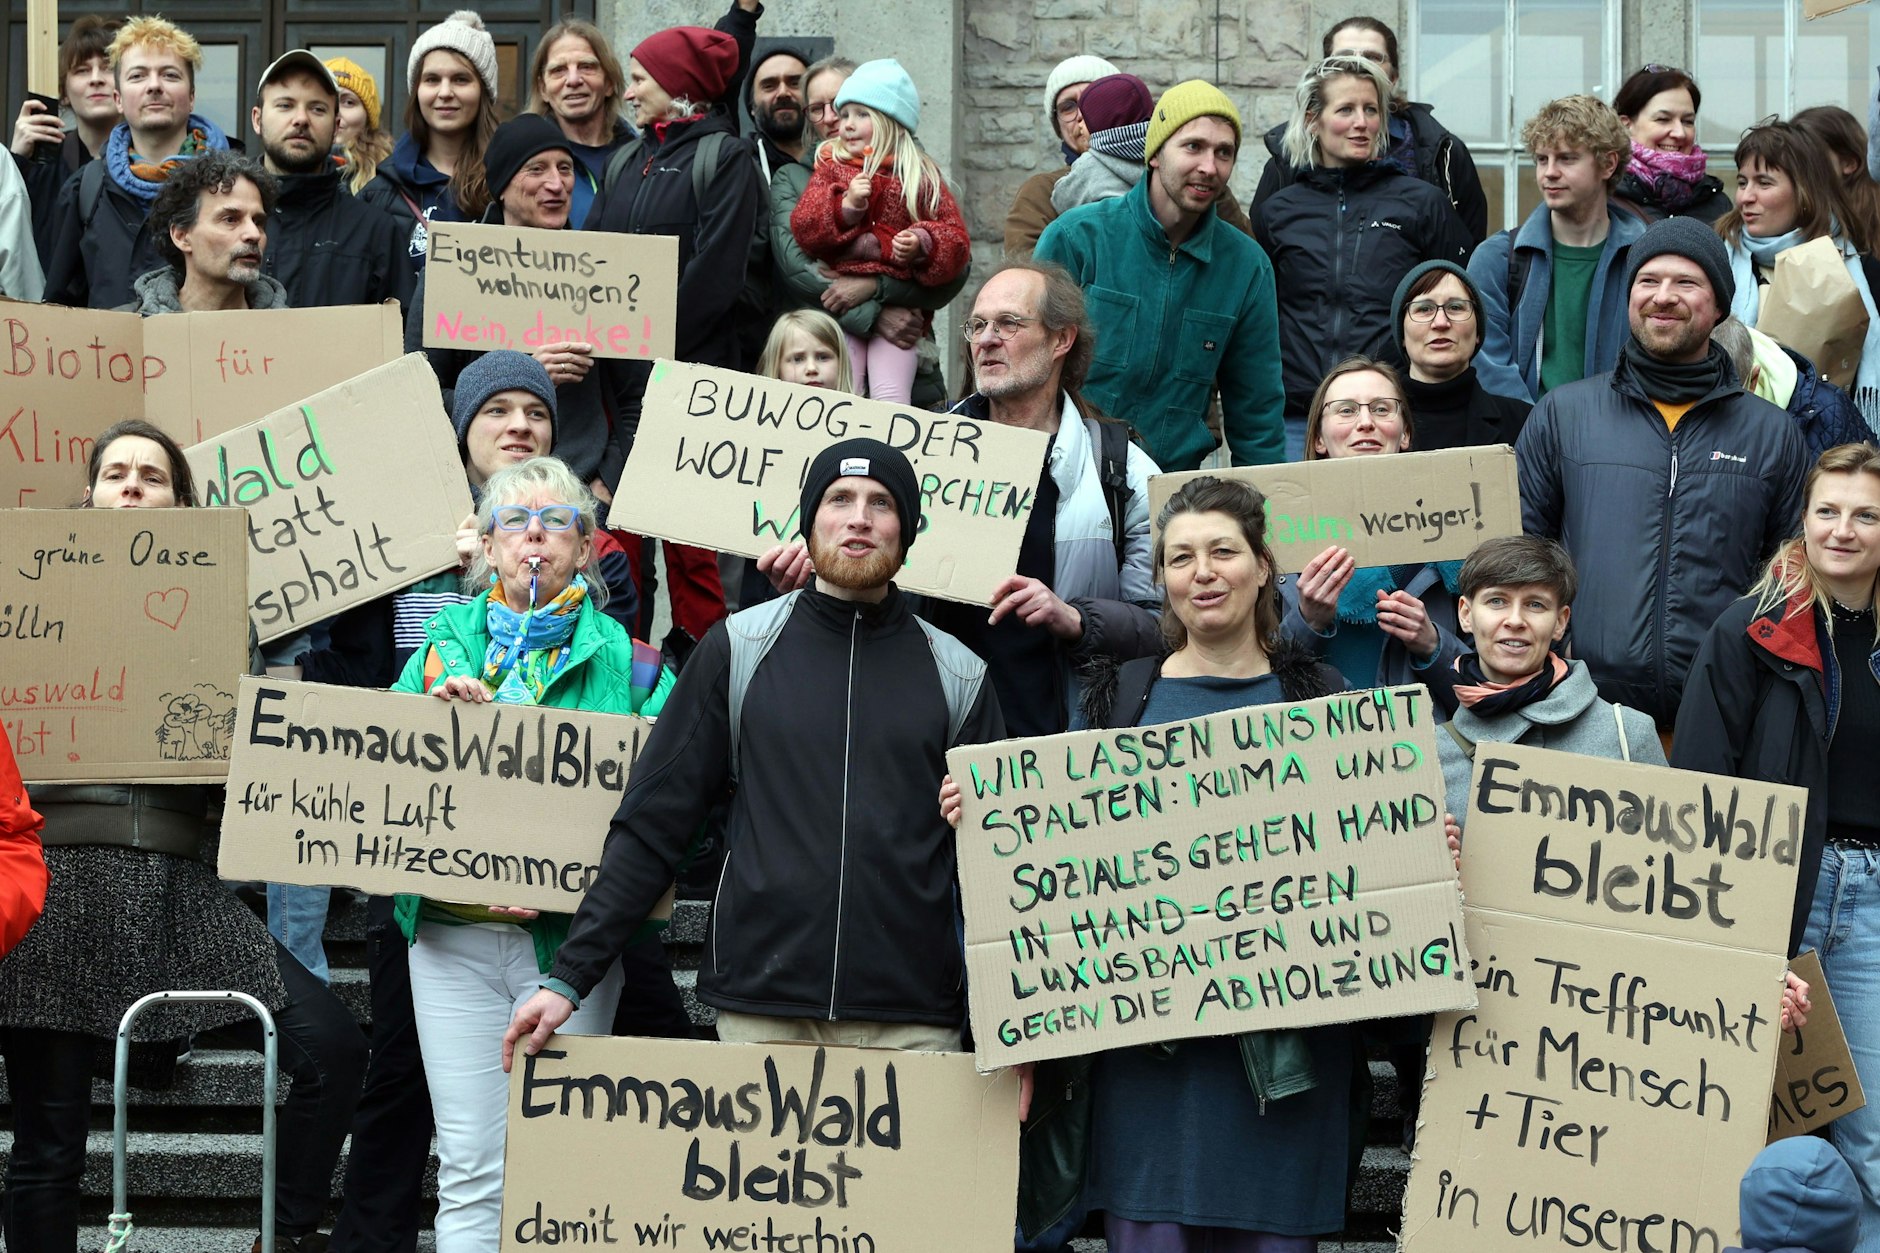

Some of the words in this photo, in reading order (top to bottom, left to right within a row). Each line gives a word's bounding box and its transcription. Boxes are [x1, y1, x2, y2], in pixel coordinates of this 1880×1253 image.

[430, 231, 607, 277] Eigentums-
[477, 272, 641, 315] wohnungen?
[3, 318, 167, 394] Biotop
[215, 340, 275, 382] für
[435, 310, 513, 349] Nein,
[522, 309, 652, 357] danke!
[675, 436, 783, 488] WOLF
[914, 458, 1033, 520] RCHEN-
[18, 533, 105, 580] grüne
[130, 530, 216, 566] Oase
[248, 486, 345, 554] tatt
[249, 522, 407, 625] sphalt
[0, 604, 64, 643] ölln
[0, 666, 126, 706] uswald
[970, 749, 1044, 800] WIR
[1065, 716, 1213, 781] LASSEN
[1232, 706, 1316, 752] UNS
[1326, 688, 1421, 740] NICHT
[1188, 752, 1311, 808] KLIMA
[1335, 742, 1425, 781] UND
[239, 780, 281, 815] für
[292, 779, 365, 825] kühle
[383, 782, 456, 836] Luft
[295, 830, 339, 866] im
[1009, 840, 1181, 914] SOZIALES
[1189, 812, 1320, 870] GEHEN
[1338, 793, 1437, 847] HAND
[1533, 834, 1736, 929] bleibt
[1009, 925, 1050, 968] IN
[1011, 919, 1288, 1001] LUXUSBAUTEN
[1309, 909, 1392, 946] UND
[998, 999, 1100, 1048] GEGEN
[1114, 988, 1172, 1026] DIE
[1194, 921, 1464, 1024] ABHOLZUNG!
[1534, 957, 1768, 1052] Treffpunkt
[1449, 1015, 1518, 1069] für
[1536, 1027, 1731, 1122] Mensch
[1505, 1090, 1609, 1167] Tier
[682, 1137, 862, 1209] bleibt
[515, 1201, 618, 1248] damit
[634, 1212, 686, 1249] wir
[703, 1217, 875, 1253] weiterhin
[1437, 1169, 1479, 1229] in
[1506, 1192, 1719, 1253] unserem
